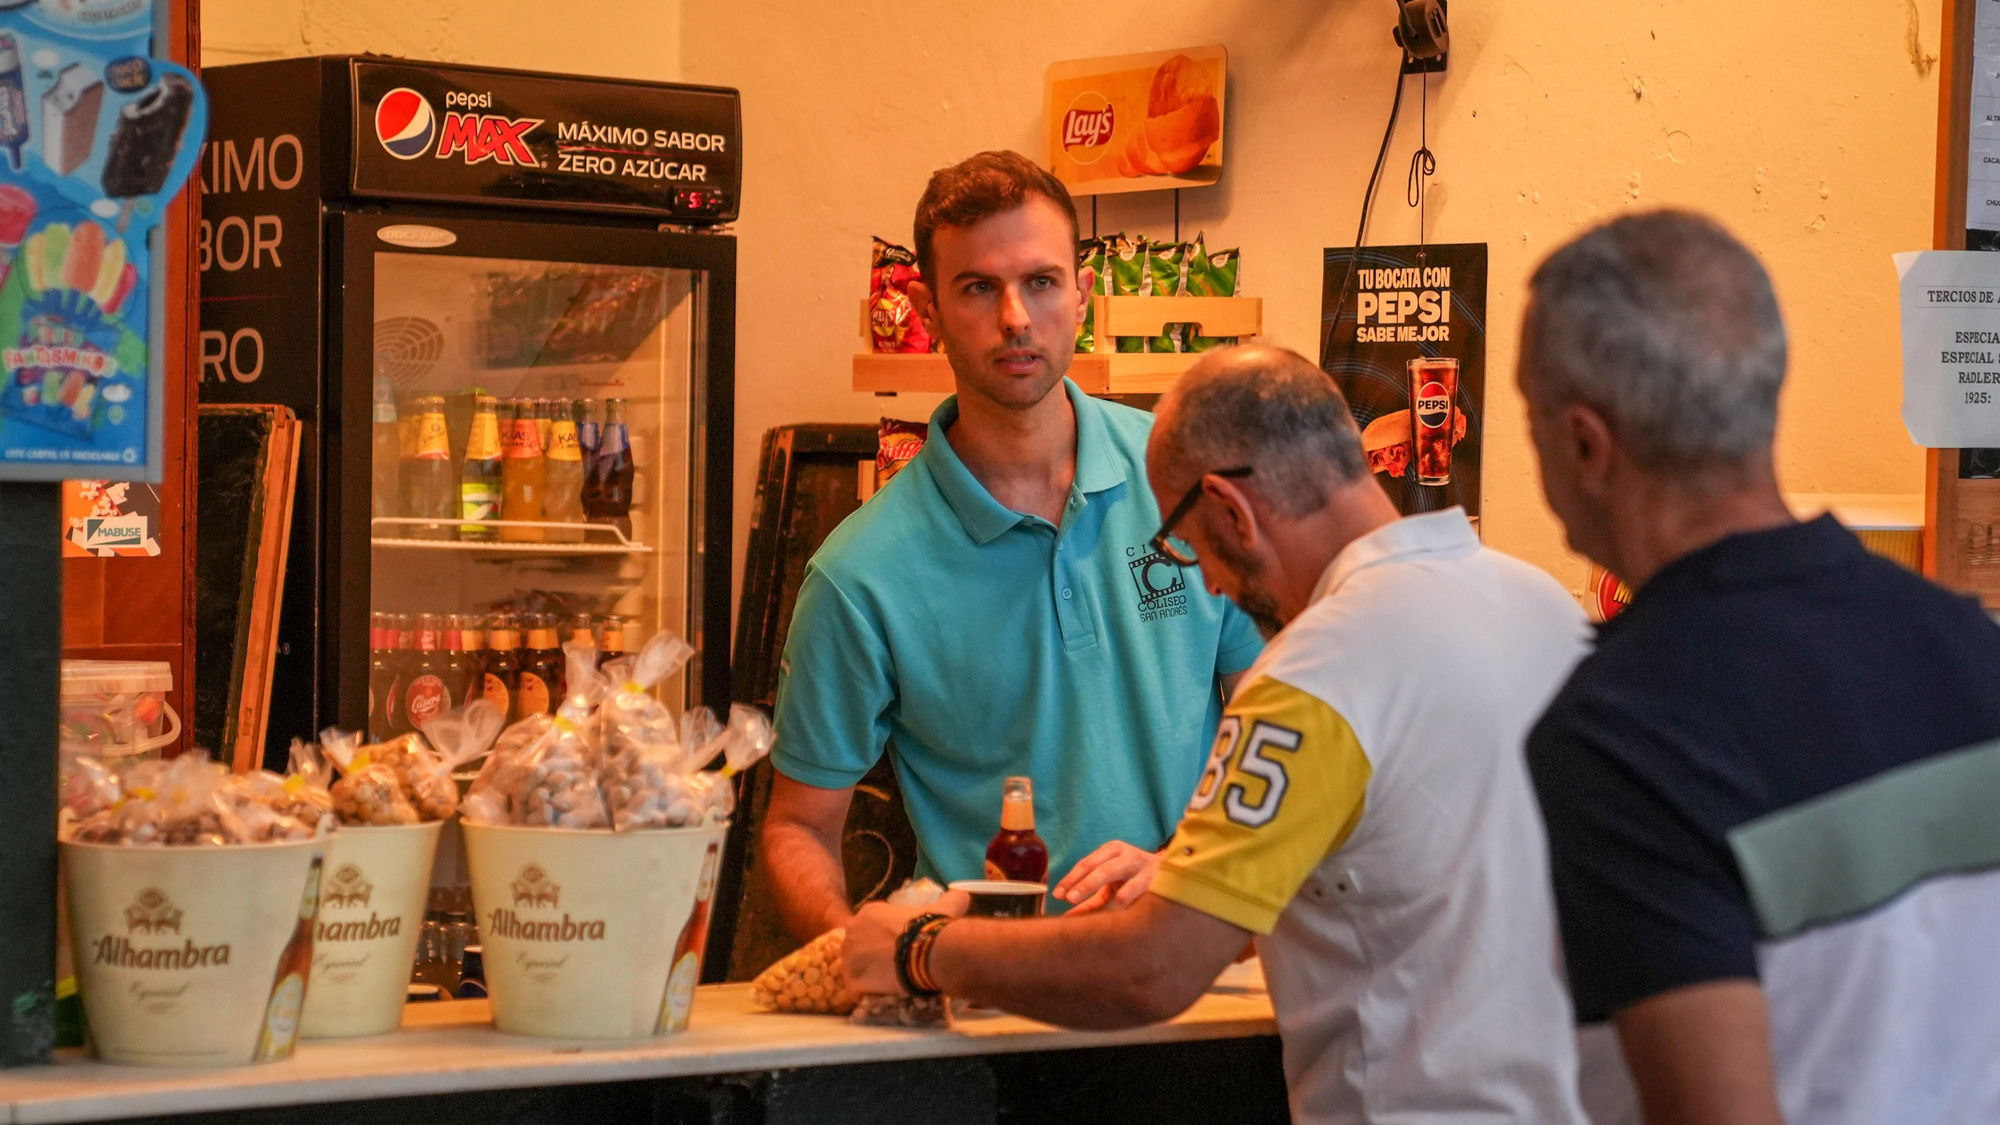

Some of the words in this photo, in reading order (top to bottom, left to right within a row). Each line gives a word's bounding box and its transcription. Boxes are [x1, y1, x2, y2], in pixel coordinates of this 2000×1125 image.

[446, 88, 491, 111] pepsi
[558, 121, 648, 146] MÁXIMO
[654, 130, 725, 152] SABOR
[1065, 106, 1112, 148] Lay's
[435, 112, 545, 167] MAX
[558, 154, 615, 175] ZERO
[621, 158, 706, 182] AZÚCAR
[1358, 268, 1374, 289] TU
[1375, 267, 1421, 289] BOCATA
[1424, 267, 1450, 288] CON
[1357, 290, 1449, 324] PEPSI
[1927, 290, 1977, 303] TERCIOS
[1979, 291, 1994, 304] DE
[1357, 327, 1396, 342] SABE
[1397, 325, 1449, 342] MEJOR
[1941, 351, 1995, 364] ESPECIAL
[1418, 400, 1448, 410] PEPSI
[1964, 392, 1991, 404] 1925:
[98, 527, 141, 537] MABUSE
[1138, 595, 1187, 612] COLISEO
[1140, 612, 1158, 623] SAN
[1184, 715, 1303, 829] 85
[486, 909, 606, 942] Alhambra
[92, 935, 233, 970] Alhambra
